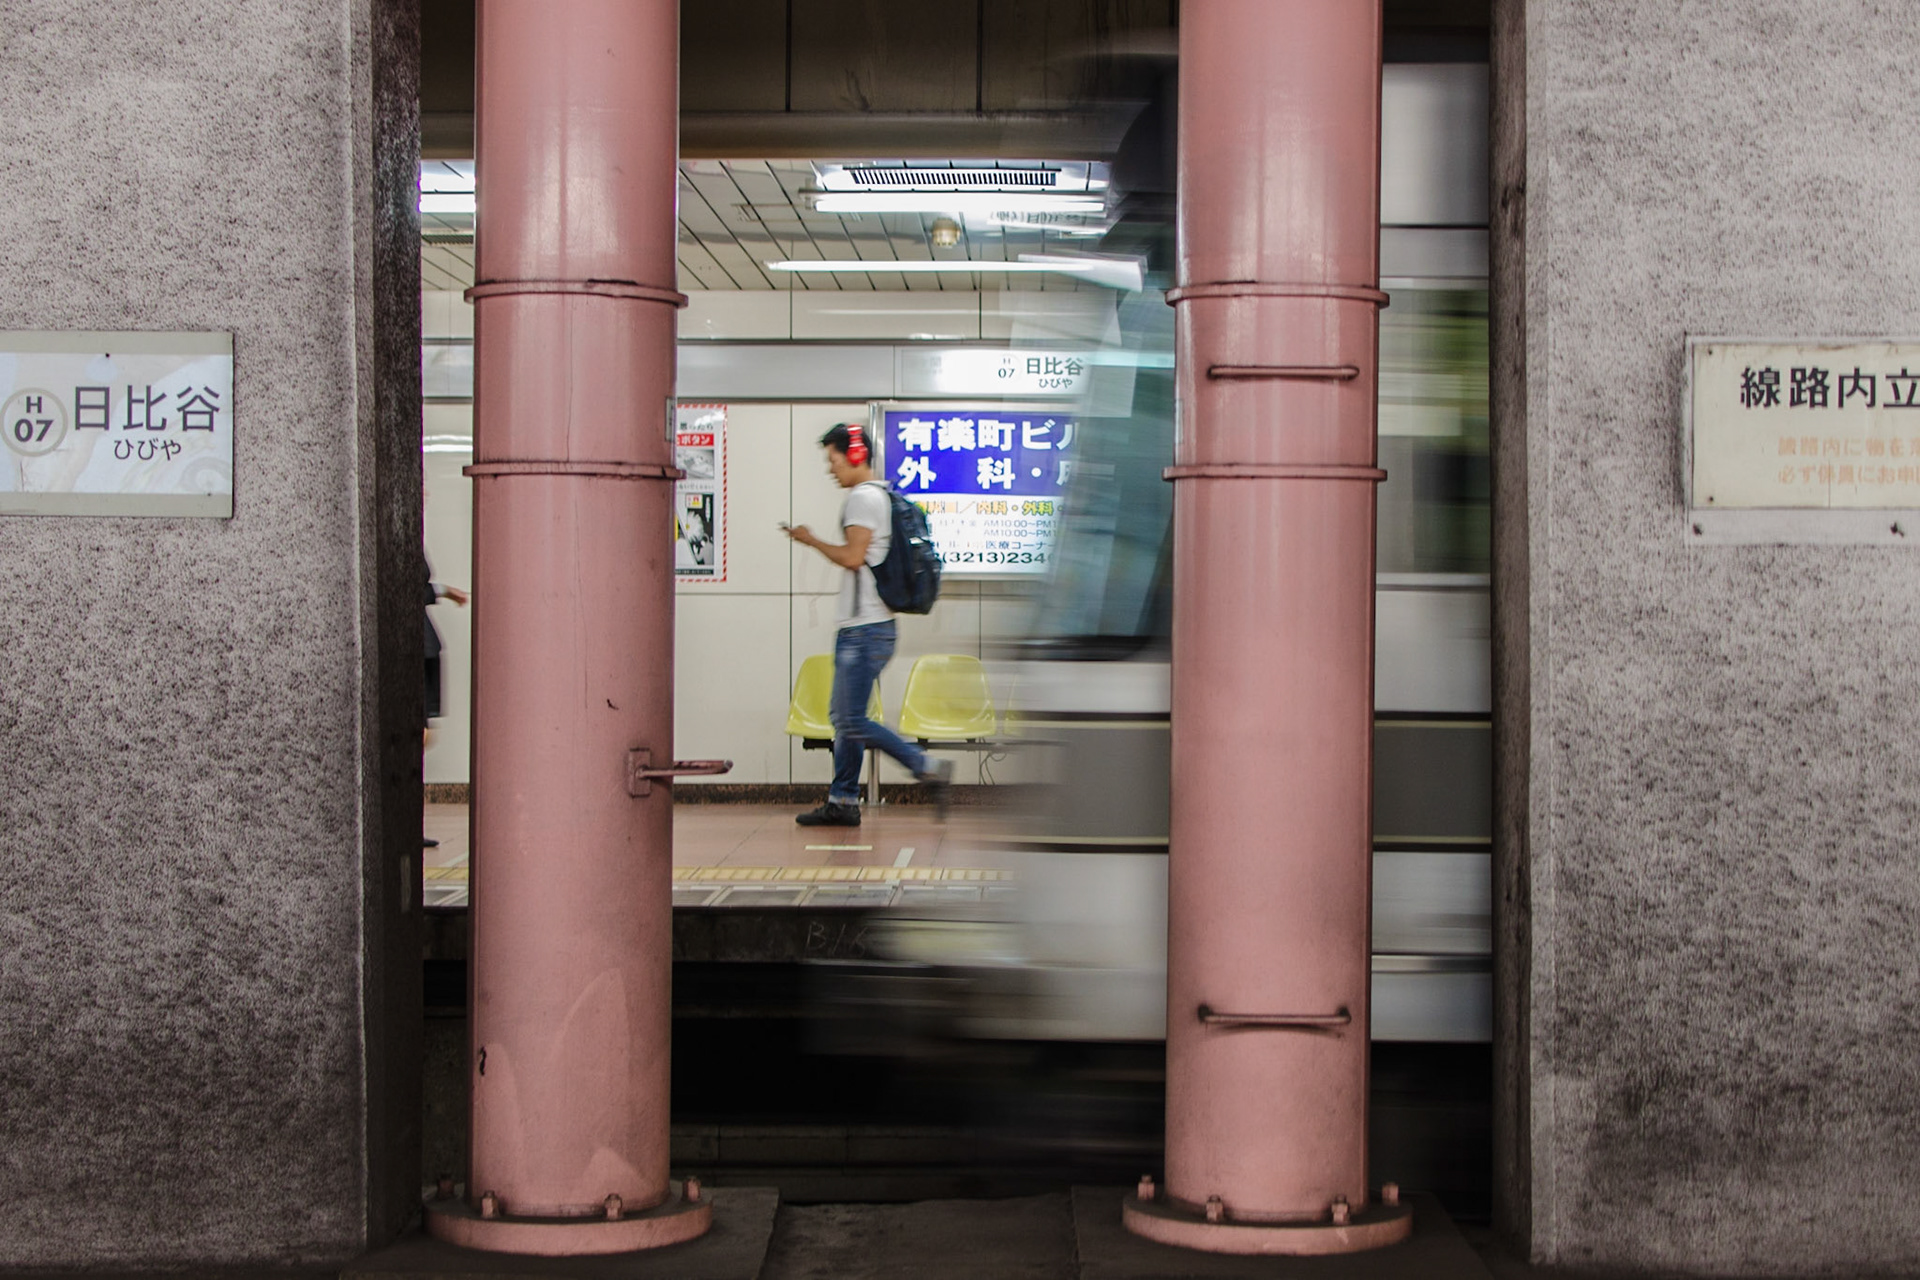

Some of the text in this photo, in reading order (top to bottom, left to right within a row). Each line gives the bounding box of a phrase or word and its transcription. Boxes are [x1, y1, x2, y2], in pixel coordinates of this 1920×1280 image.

[998, 367, 1016, 379] 07
[1026, 357, 1084, 376] 日比谷
[1038, 377, 1073, 389] ひびや
[1740, 366, 1920, 409] 線路内立
[25, 396, 42, 414] H
[75, 384, 220, 433] 日比谷
[14, 418, 54, 442] 07
[114, 438, 182, 461] ひびや
